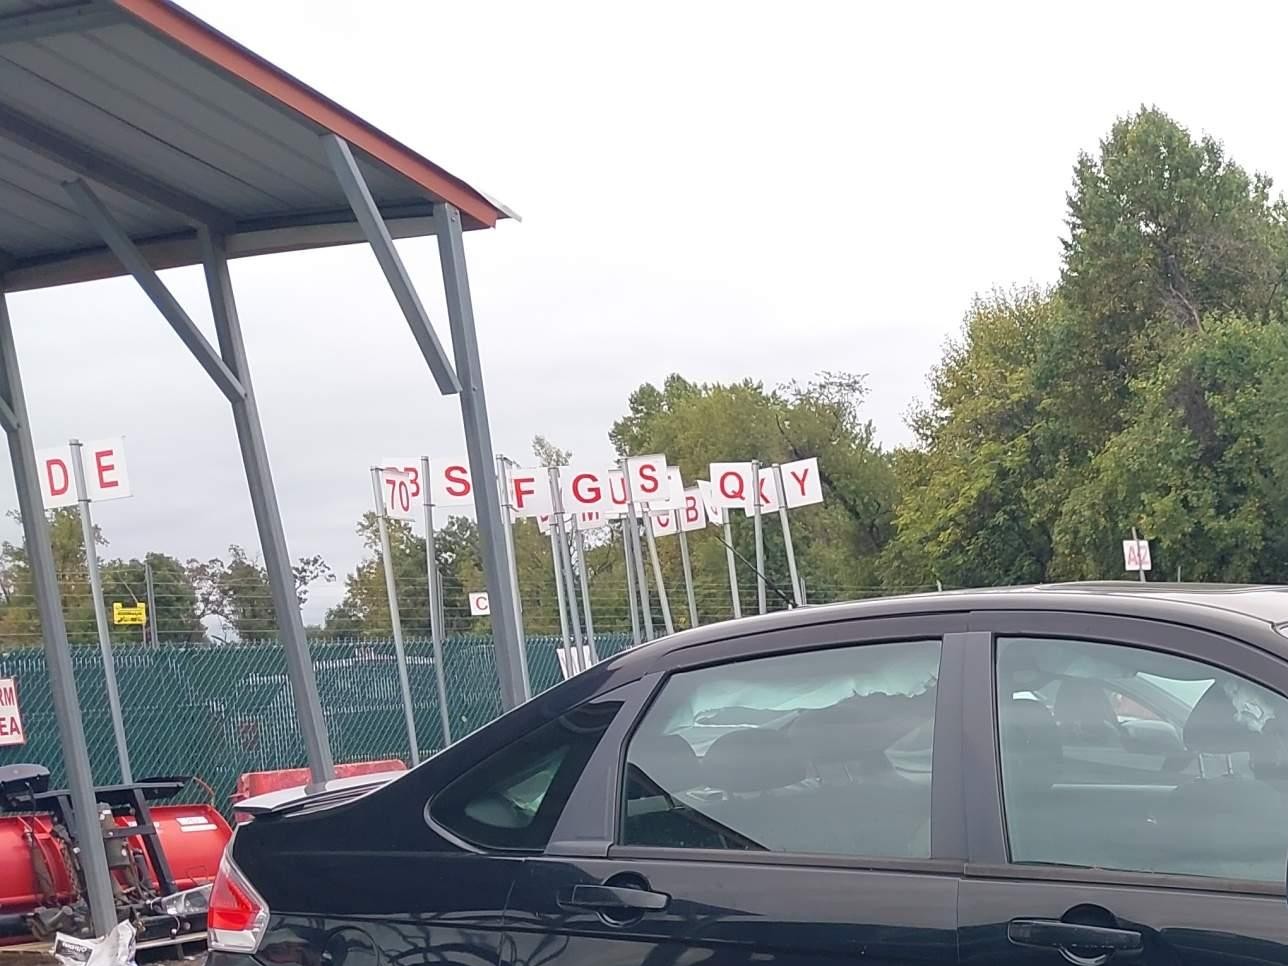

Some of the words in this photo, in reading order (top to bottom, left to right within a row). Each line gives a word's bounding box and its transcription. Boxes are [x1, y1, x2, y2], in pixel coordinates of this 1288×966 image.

[46, 459, 68, 496] D
[95, 450, 118, 488] E
[445, 466, 470, 496] S
[638, 464, 658, 493] S
[791, 468, 808, 496] Y
[386, 479, 410, 512] 70
[513, 478, 535, 508] F
[572, 474, 601, 504] G
[720, 471, 745, 500] Q
[685, 496, 698, 522] B
[476, 596, 488, 610] C
